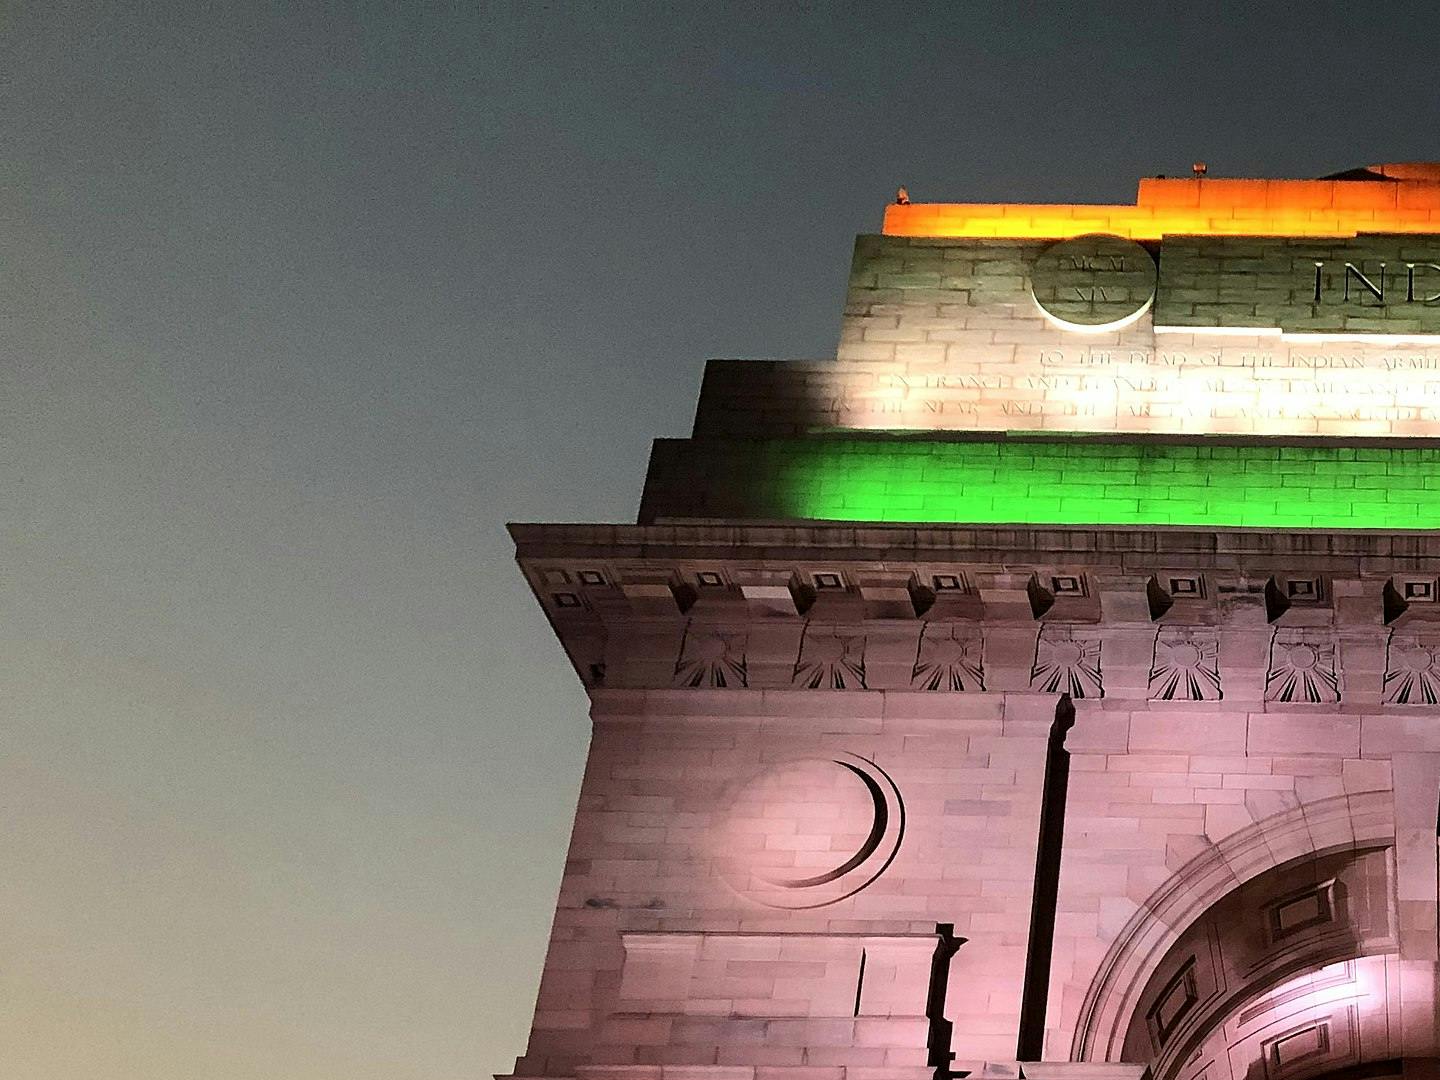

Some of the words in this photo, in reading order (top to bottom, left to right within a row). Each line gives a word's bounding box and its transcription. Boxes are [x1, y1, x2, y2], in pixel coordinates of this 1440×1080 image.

[1039, 349, 1065, 366] TO
[1079, 350, 1112, 366] THE
[1129, 350, 1187, 367] DEAD
[1240, 351, 1274, 368] THE
[1291, 352, 1365, 369] INDIAN
[924, 374, 1004, 389] FRANCE
